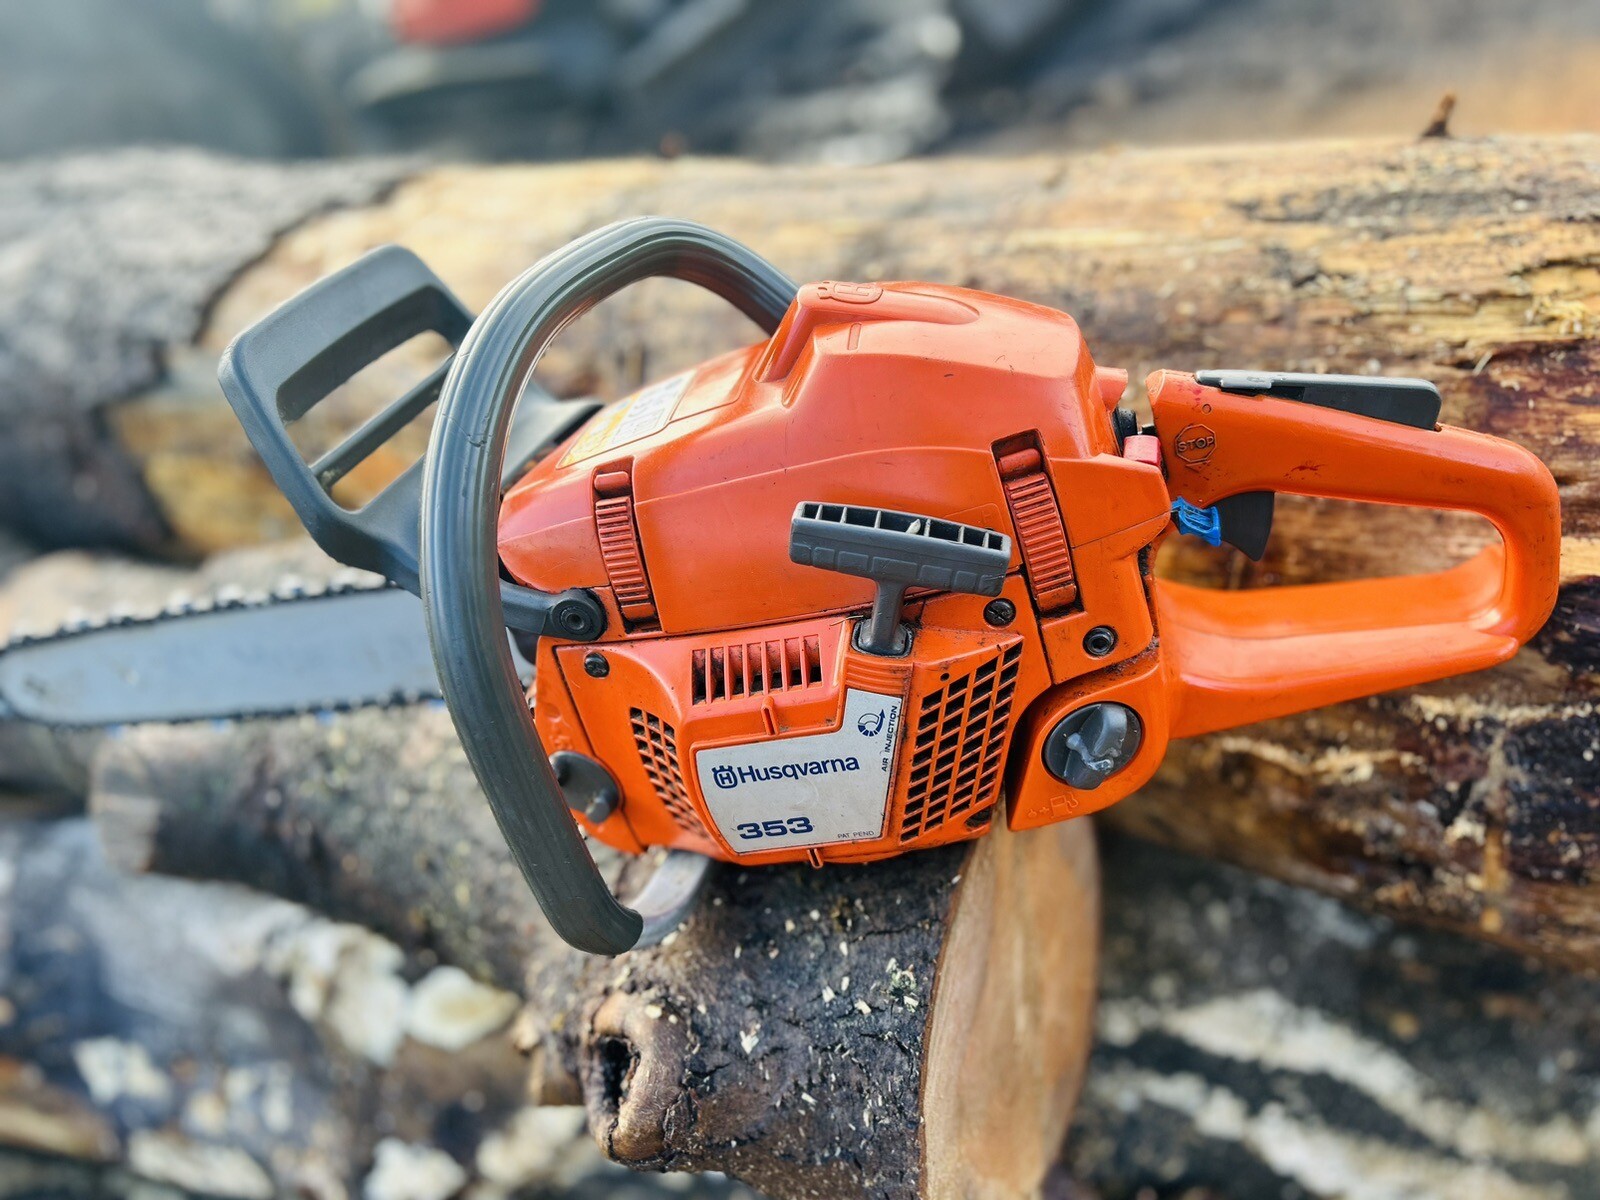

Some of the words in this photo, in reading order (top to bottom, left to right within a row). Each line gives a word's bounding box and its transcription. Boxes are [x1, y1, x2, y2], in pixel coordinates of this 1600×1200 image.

[1178, 436, 1214, 451] STOP
[881, 757, 889, 772] AIR
[885, 705, 898, 753] INJECTION
[737, 756, 860, 783] Husqvarna
[737, 816, 814, 840] 353
